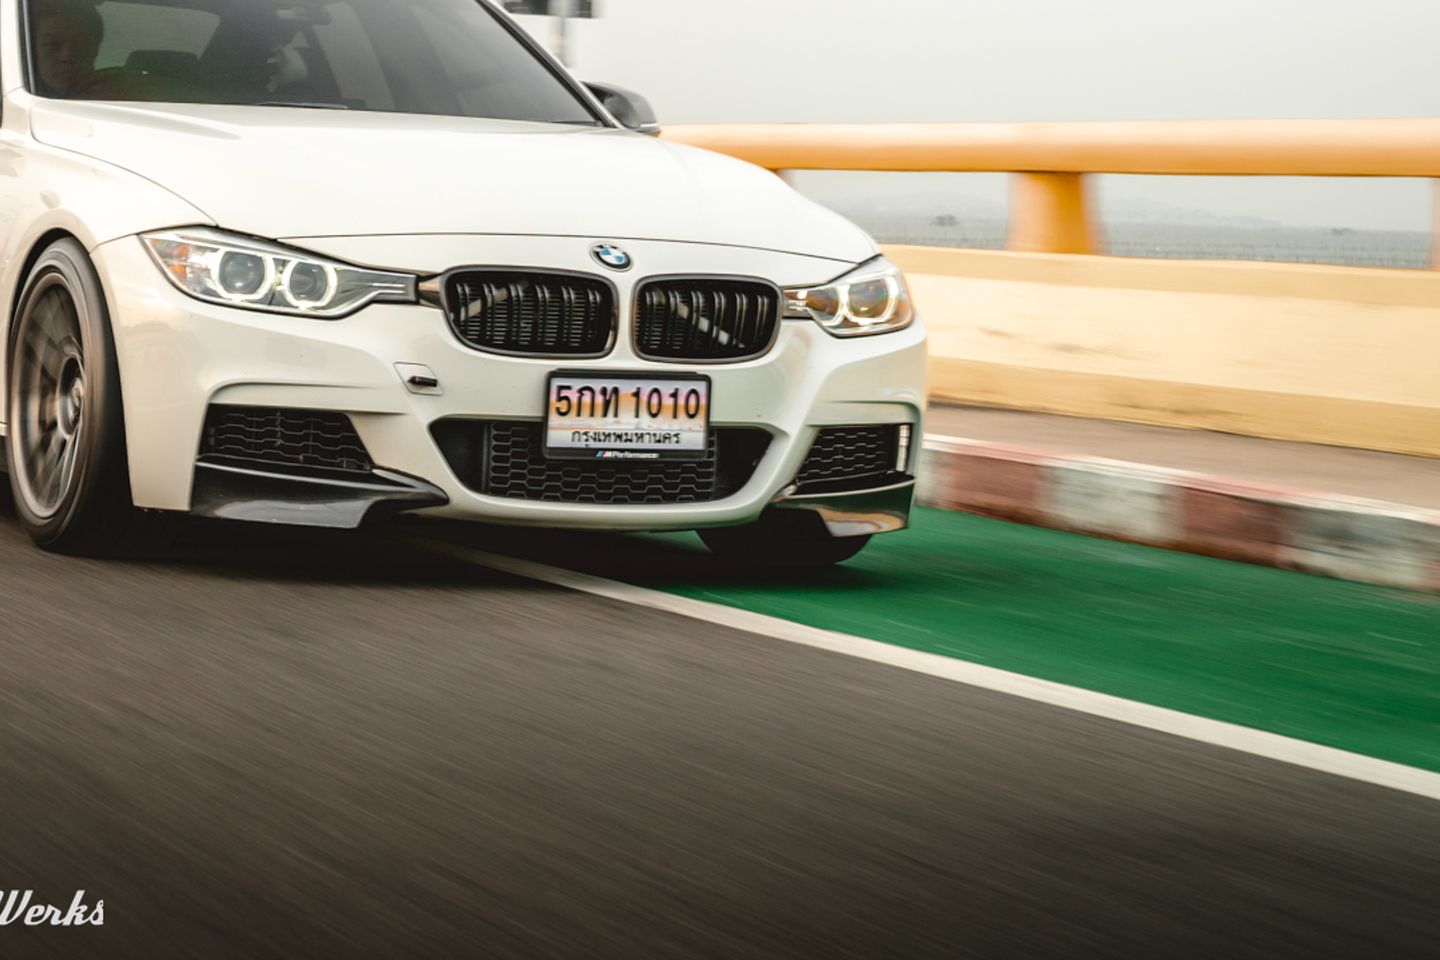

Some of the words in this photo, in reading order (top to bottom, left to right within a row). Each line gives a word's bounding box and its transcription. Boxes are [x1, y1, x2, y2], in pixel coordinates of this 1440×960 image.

[555, 385, 620, 418] 5กท
[631, 386, 700, 419] 1010
[571, 430, 681, 448] กรุงเทพมหานคร
